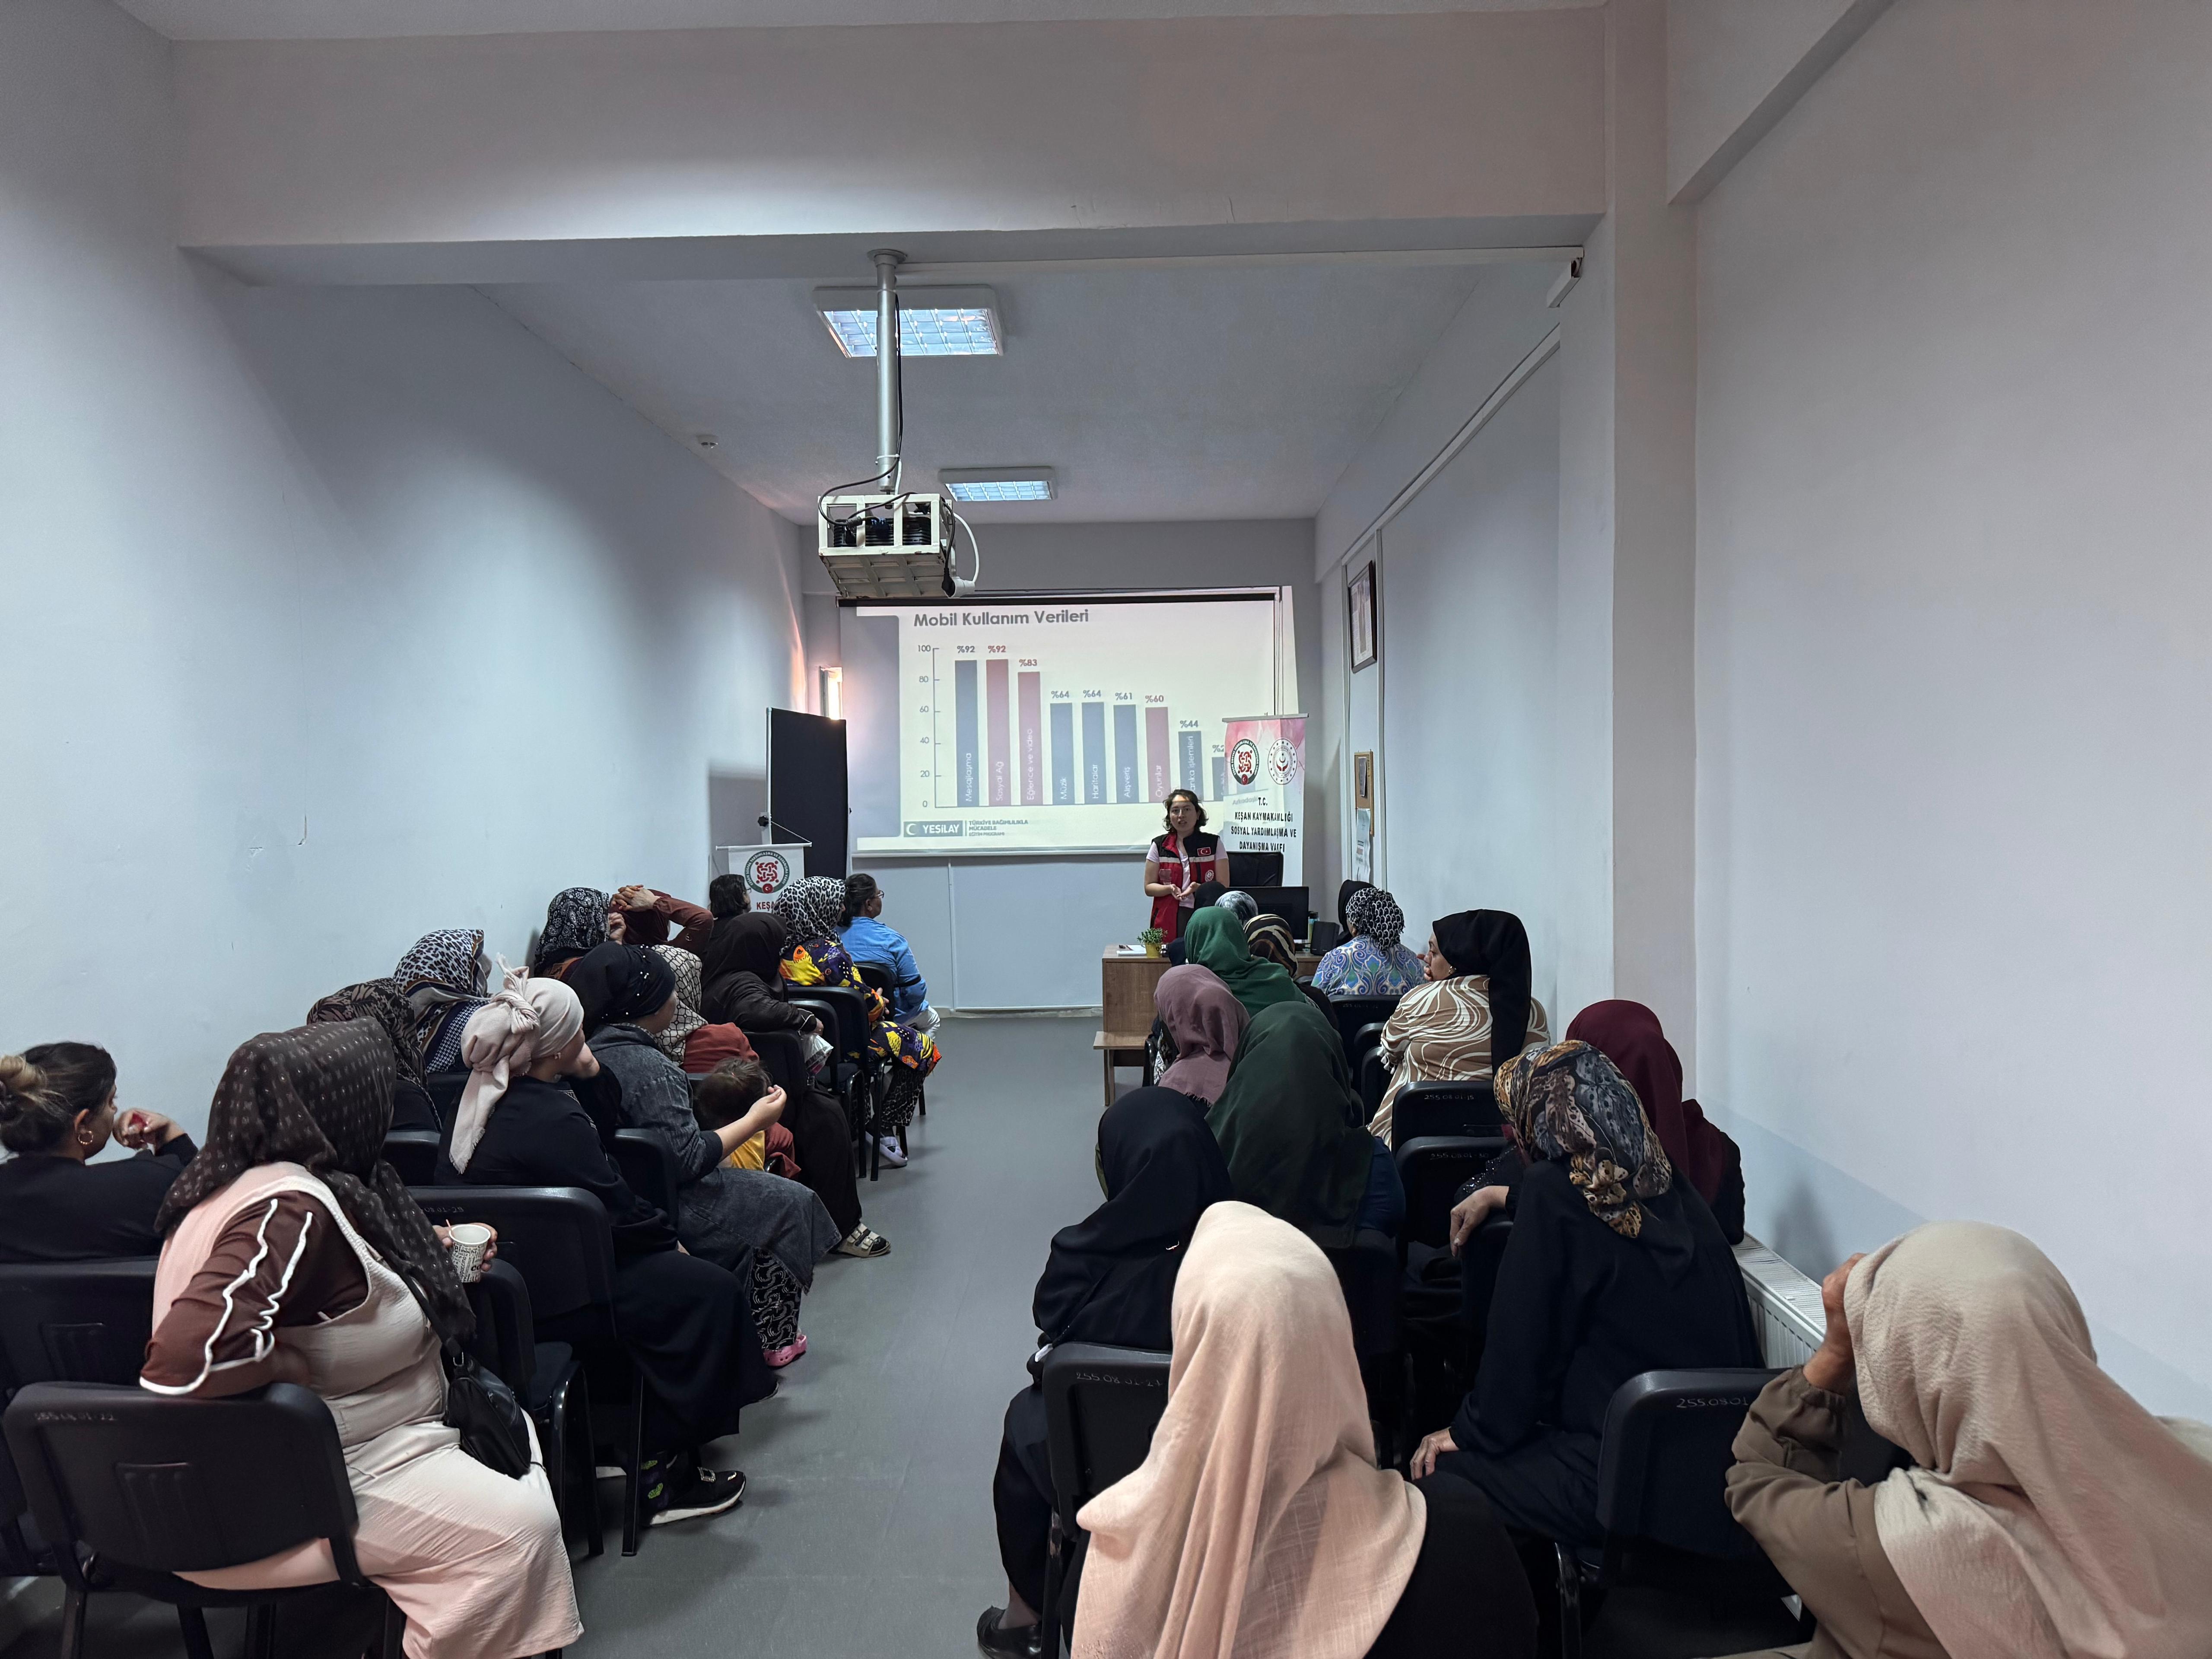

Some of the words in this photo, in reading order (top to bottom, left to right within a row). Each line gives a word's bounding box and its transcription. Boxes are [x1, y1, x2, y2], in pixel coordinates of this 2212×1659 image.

[914, 613, 957, 626] Mobil
[963, 612, 1029, 626] Kullanım
[1034, 609, 1089, 623] Verileri
[1083, 690, 1101, 698] %64
[1115, 692, 1132, 700] %61
[1145, 695, 1164, 703] %60
[1179, 720, 1198, 728] %44
[1212, 744, 1224, 753] %2
[1027, 753, 1033, 765] ve
[996, 775, 1006, 801] Sosyal
[1027, 766, 1035, 800] Eğlence
[1258, 797, 1268, 806] T.C.
[1235, 812, 1251, 822] KEŞAN
[1252, 811, 1293, 822] KAYMAKAMLIĞI
[1231, 826, 1250, 835] SOSYAL
[1251, 827, 1288, 839] YARDIMLAŞMA
[1290, 829, 1297, 838] VE
[1239, 841, 1269, 851] DAYANIŞMA
[756, 901, 775, 911] KEŞA
